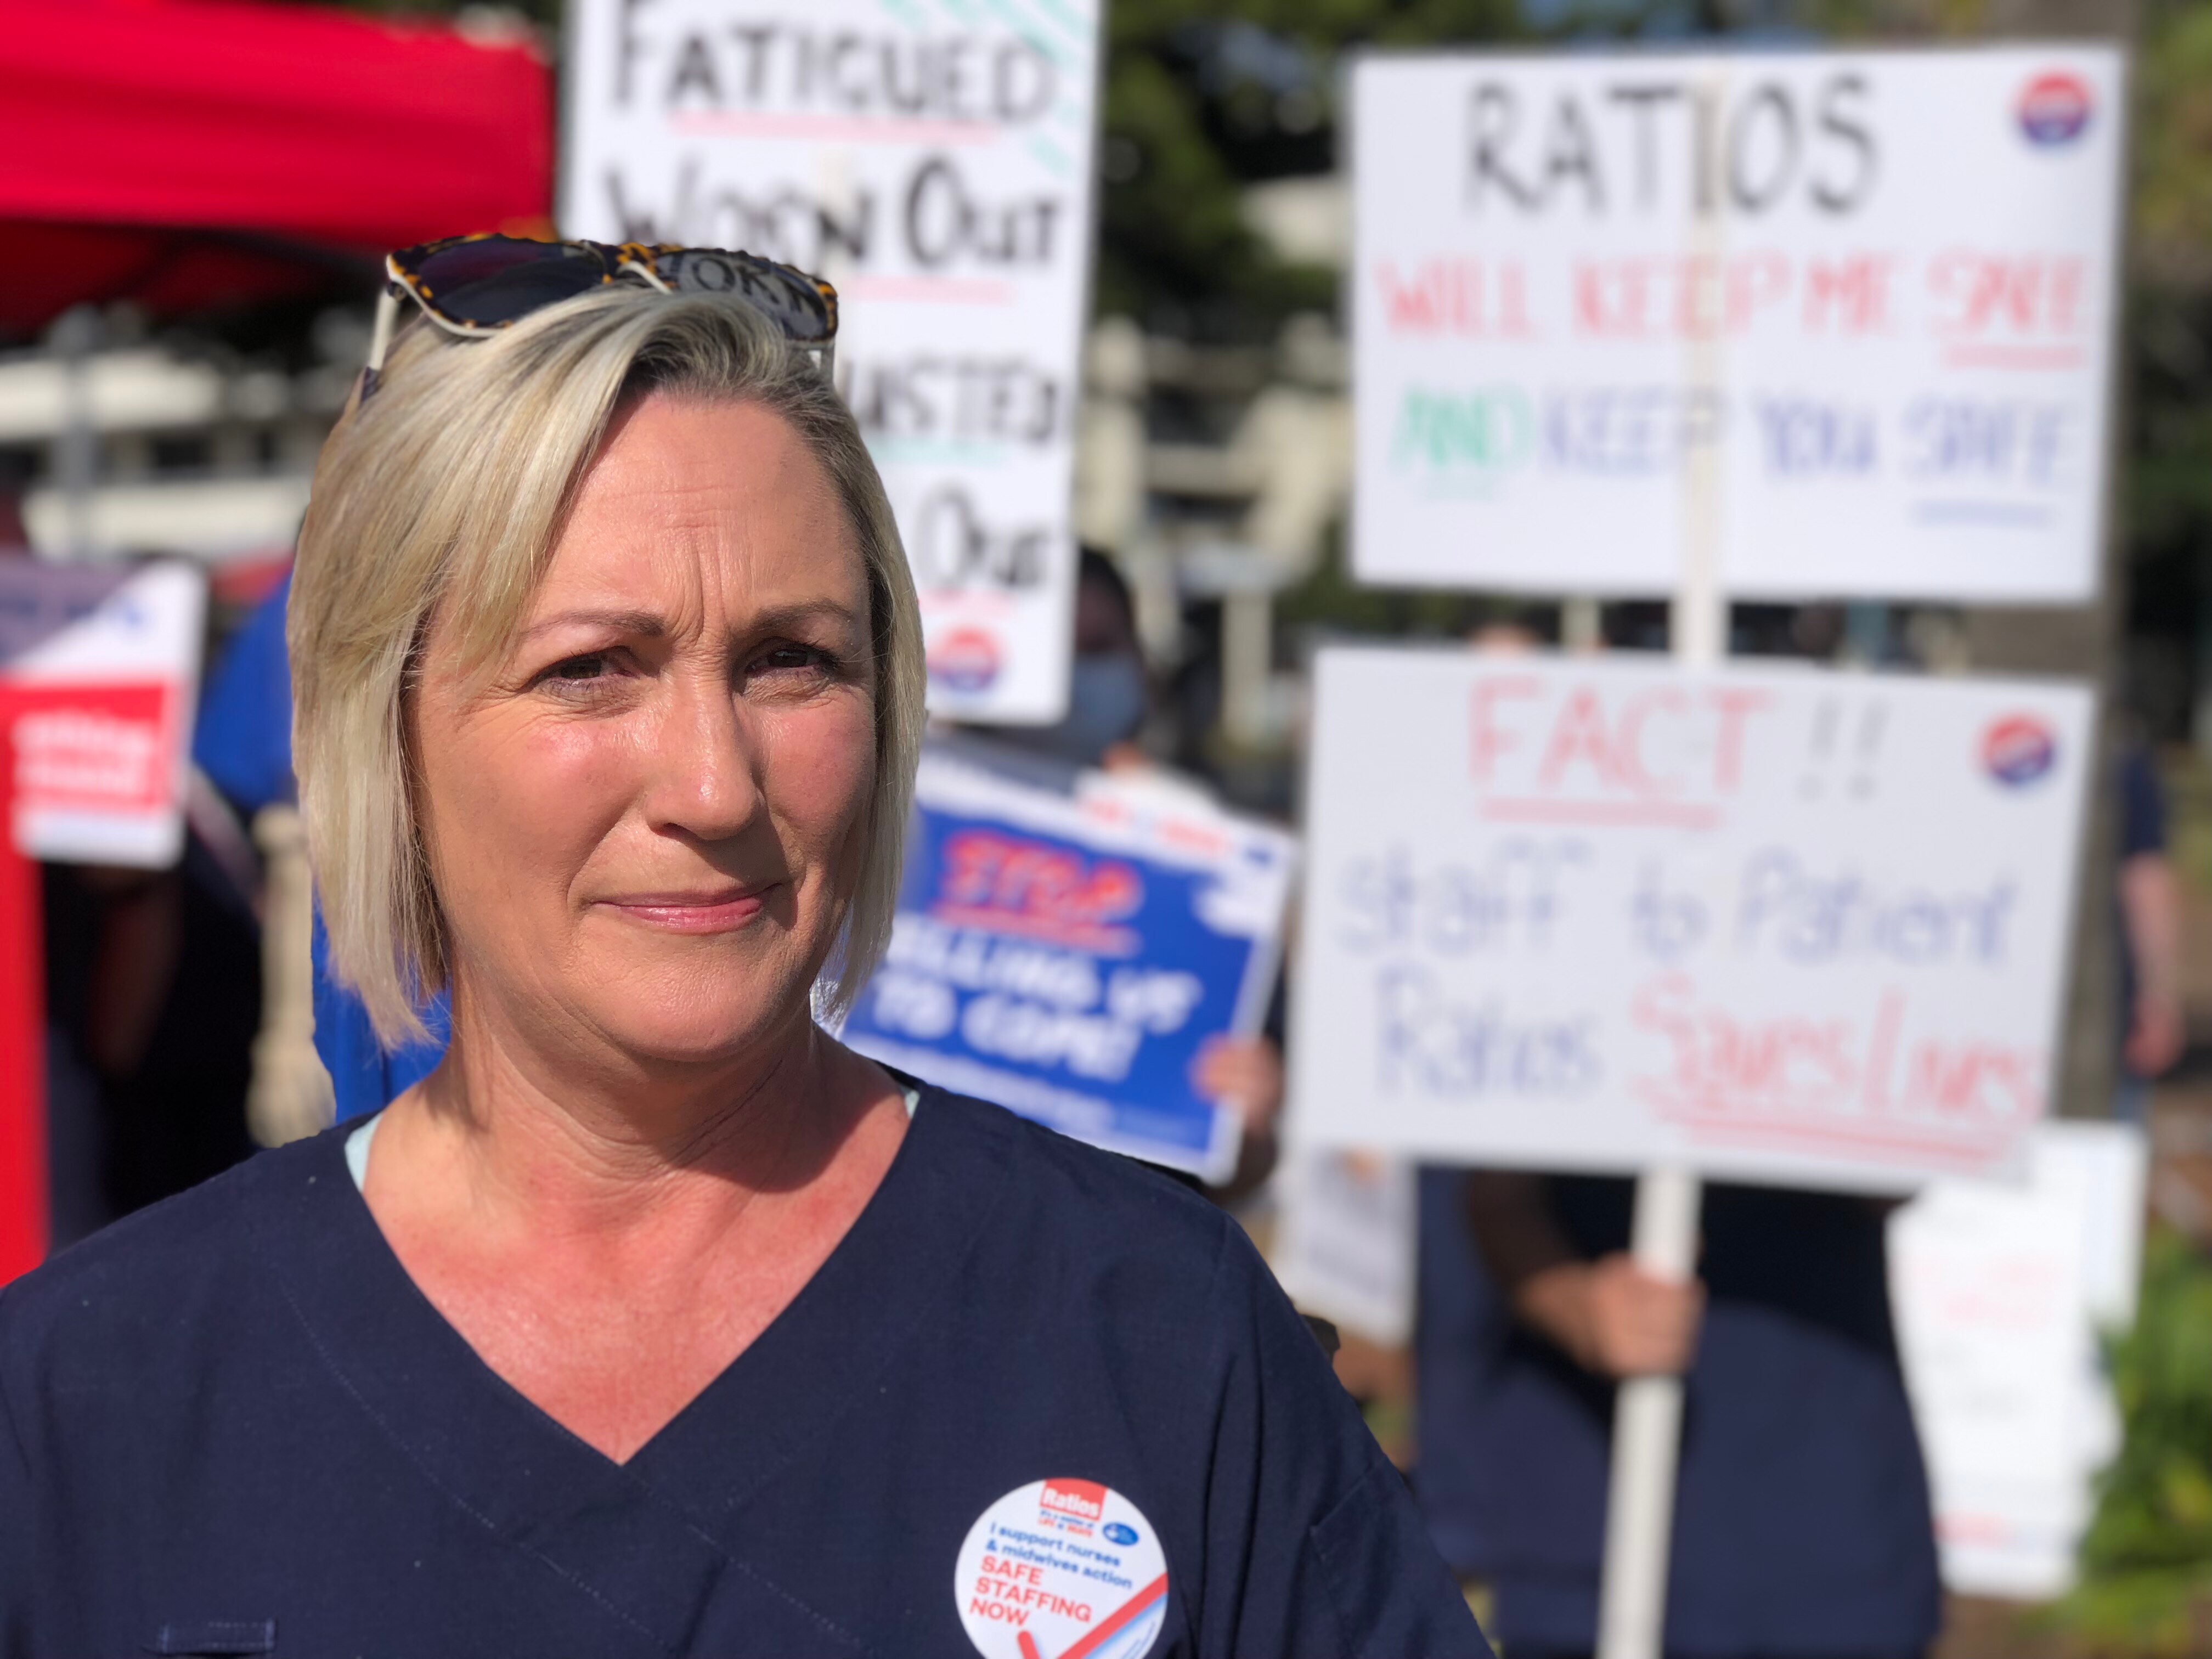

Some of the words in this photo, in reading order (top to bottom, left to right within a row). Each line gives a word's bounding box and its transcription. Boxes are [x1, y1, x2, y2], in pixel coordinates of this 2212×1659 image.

[1462, 67, 1878, 217] RATIOS
[1373, 253, 1539, 343] WILL
[1567, 251, 1793, 342] KEEP
[1802, 247, 1904, 338] ME
[1389, 381, 1536, 475] AND
[1466, 673, 1776, 795] FACT
[1629, 854, 1711, 964] to
[1373, 958, 1607, 1103] Ratios
[1043, 1487, 1100, 1518] Ratios
[981, 1555, 1043, 1586] SAFE
[985, 1539, 998, 1551] &
[1001, 1542, 1079, 1573] midwives
[1082, 1565, 1133, 1589] action
[998, 1527, 1063, 1551] support
[1066, 1544, 1121, 1567] nurses
[969, 1597, 1029, 1626] NOW
[975, 1576, 1093, 1623] STAFFING
